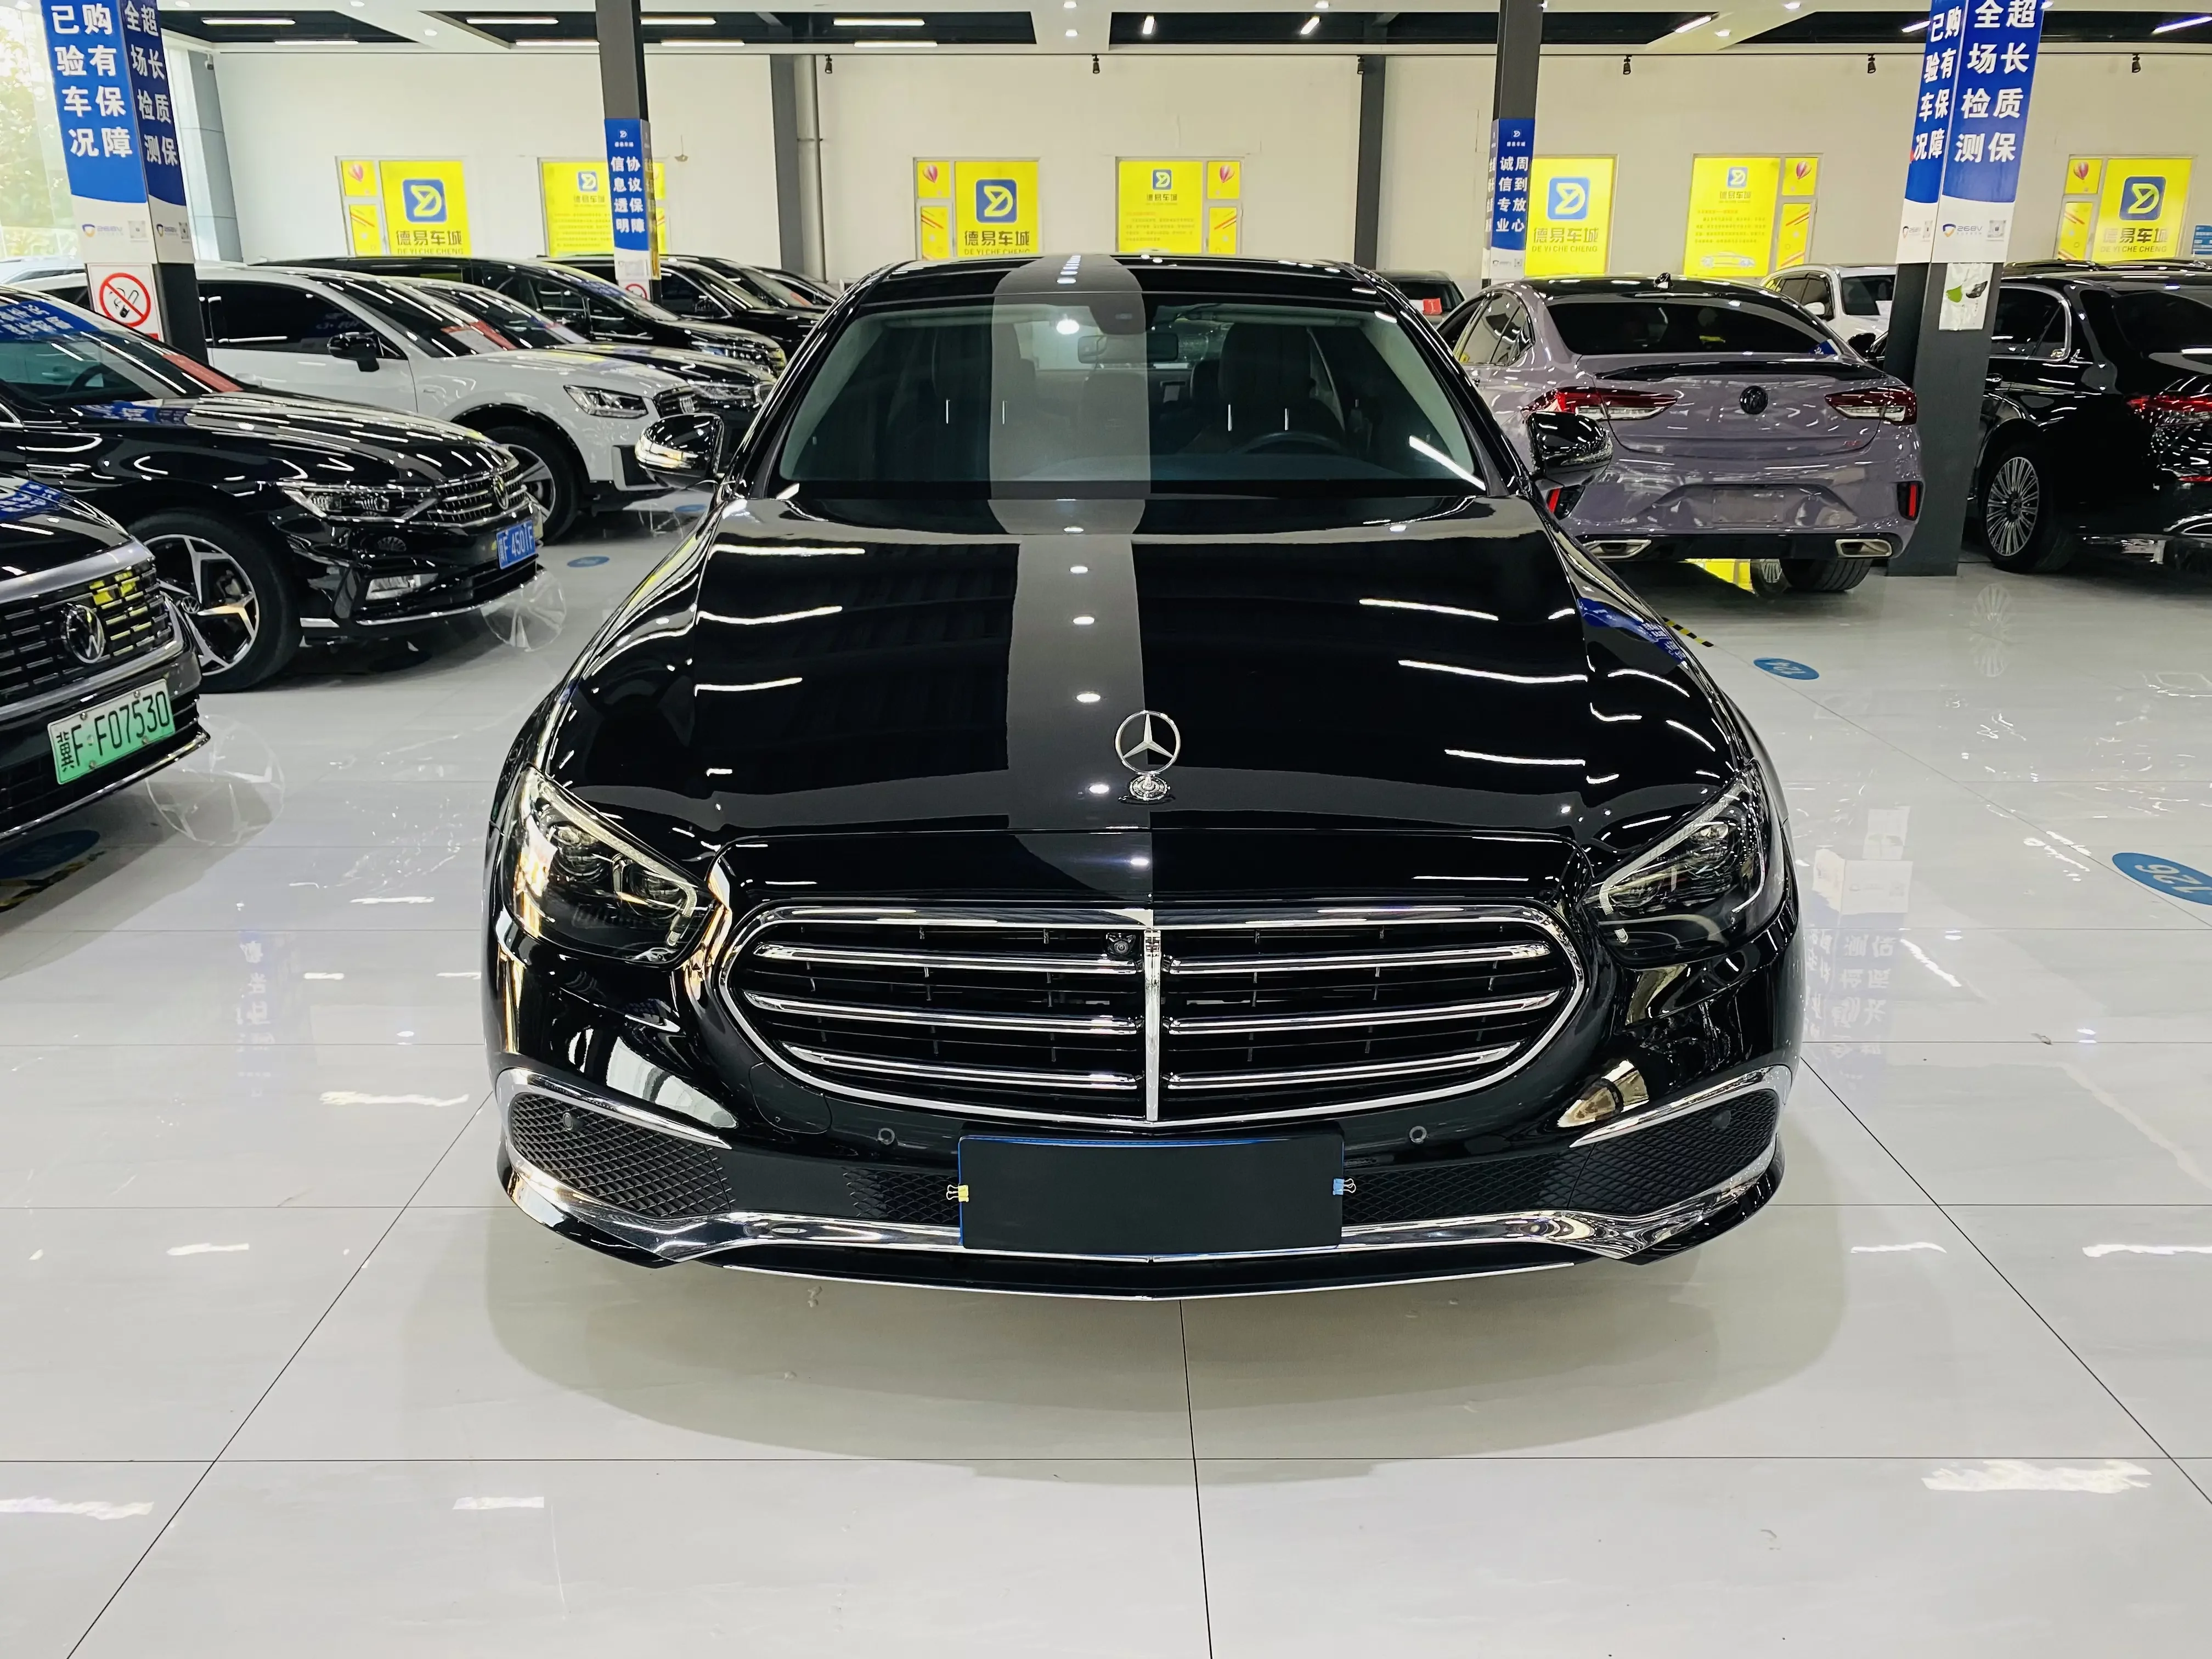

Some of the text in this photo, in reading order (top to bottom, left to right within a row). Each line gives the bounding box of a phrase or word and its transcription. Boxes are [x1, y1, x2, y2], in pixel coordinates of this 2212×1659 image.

[50, 4, 99, 157] 已验车况
[82, 4, 133, 157] 购有保障
[124, 0, 161, 164] 全场检测
[142, 4, 178, 166] 超长质保
[1914, 14, 1945, 160] 已验车况
[1928, 5, 1962, 159] 购有保障
[1954, 0, 2004, 163] 全场检测
[1988, 0, 2036, 162] 超长质保
[396, 230, 462, 246] 德易车城
[611, 156, 630, 233] 信息透明
[627, 156, 645, 233] 协议保障
[964, 230, 1030, 246] 德易车城
[1496, 156, 1514, 232] 诚信专业
[1511, 156, 1529, 232] 周到放心
[1533, 227, 1599, 243] 德易车城
[2134, 865, 2212, 893] 126
